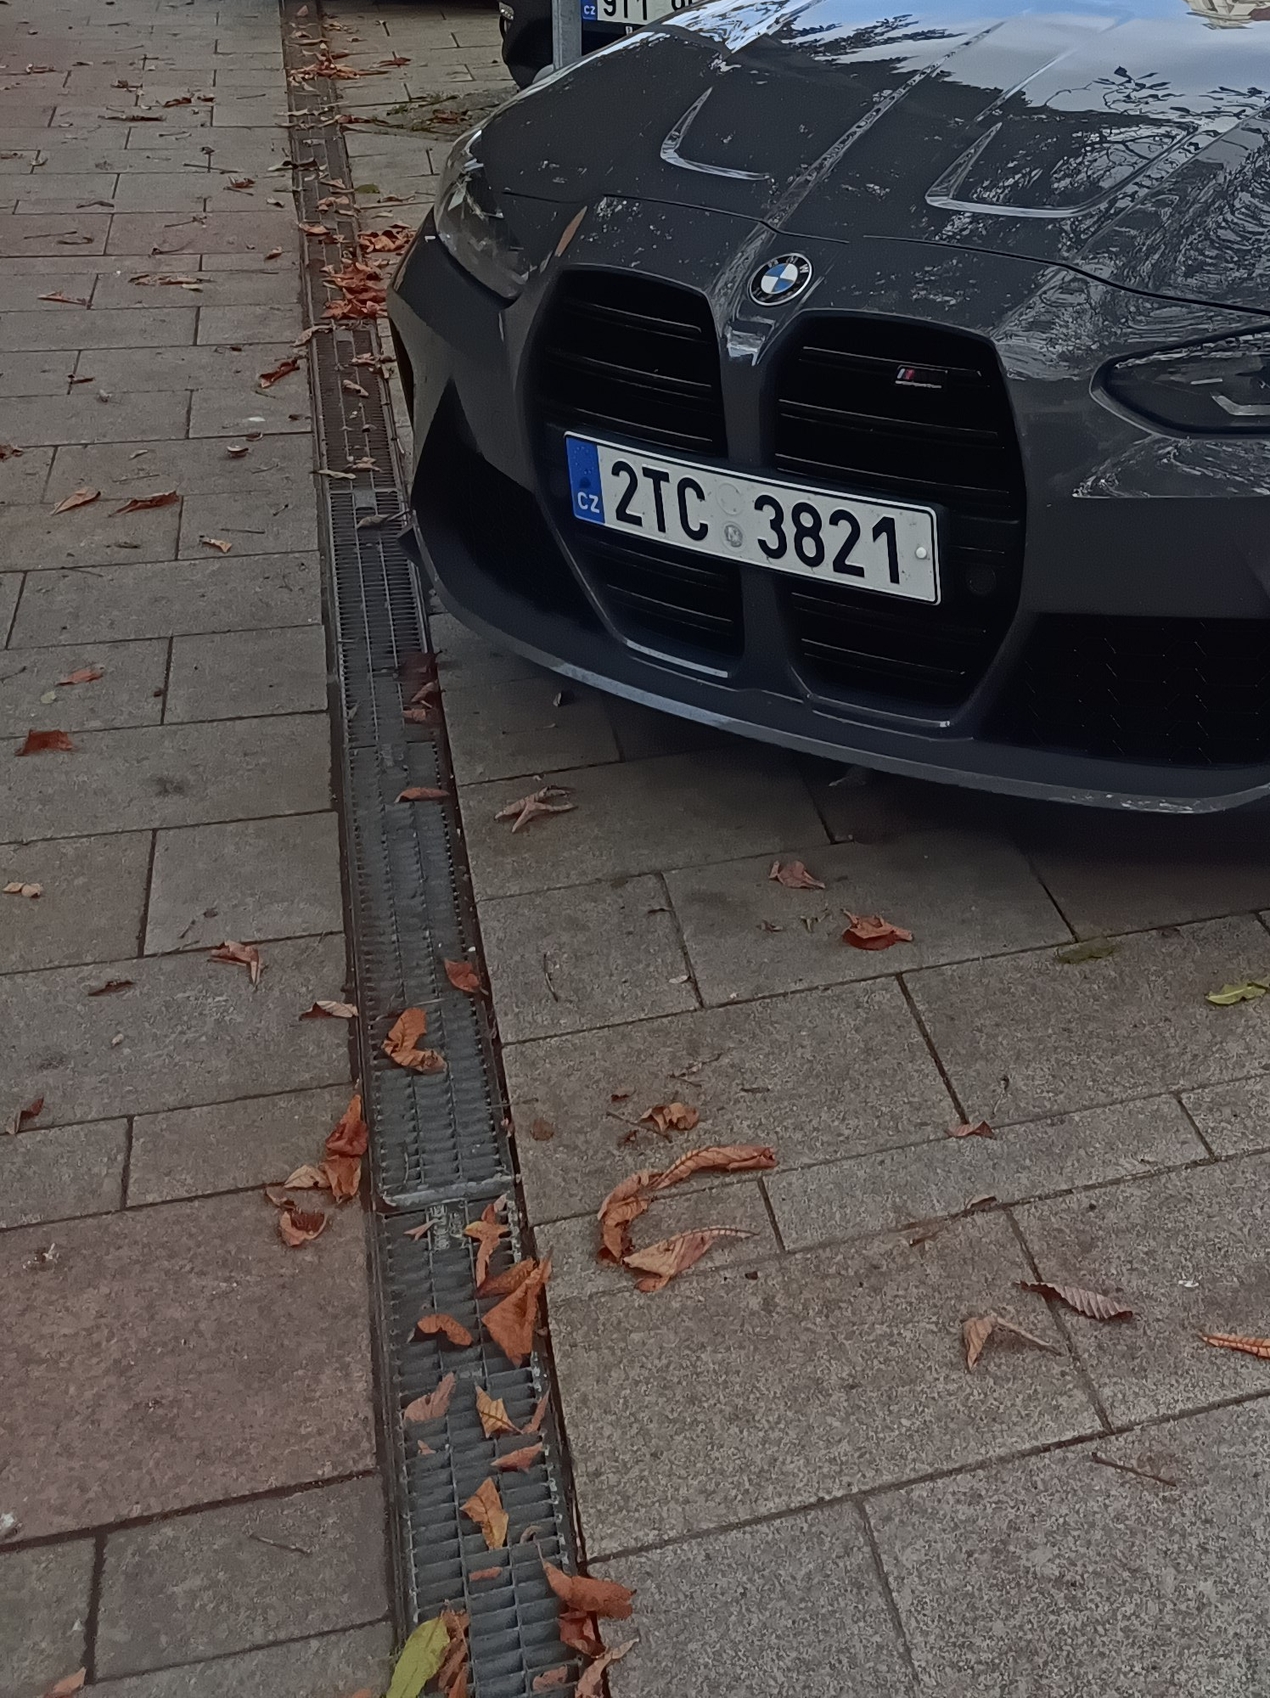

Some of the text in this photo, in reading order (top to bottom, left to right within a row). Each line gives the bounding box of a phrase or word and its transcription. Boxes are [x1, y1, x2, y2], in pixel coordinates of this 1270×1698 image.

[583, 5, 596, 15] CZ
[577, 491, 600, 514] CZ
[611, 460, 900, 585] 2TC 3821
